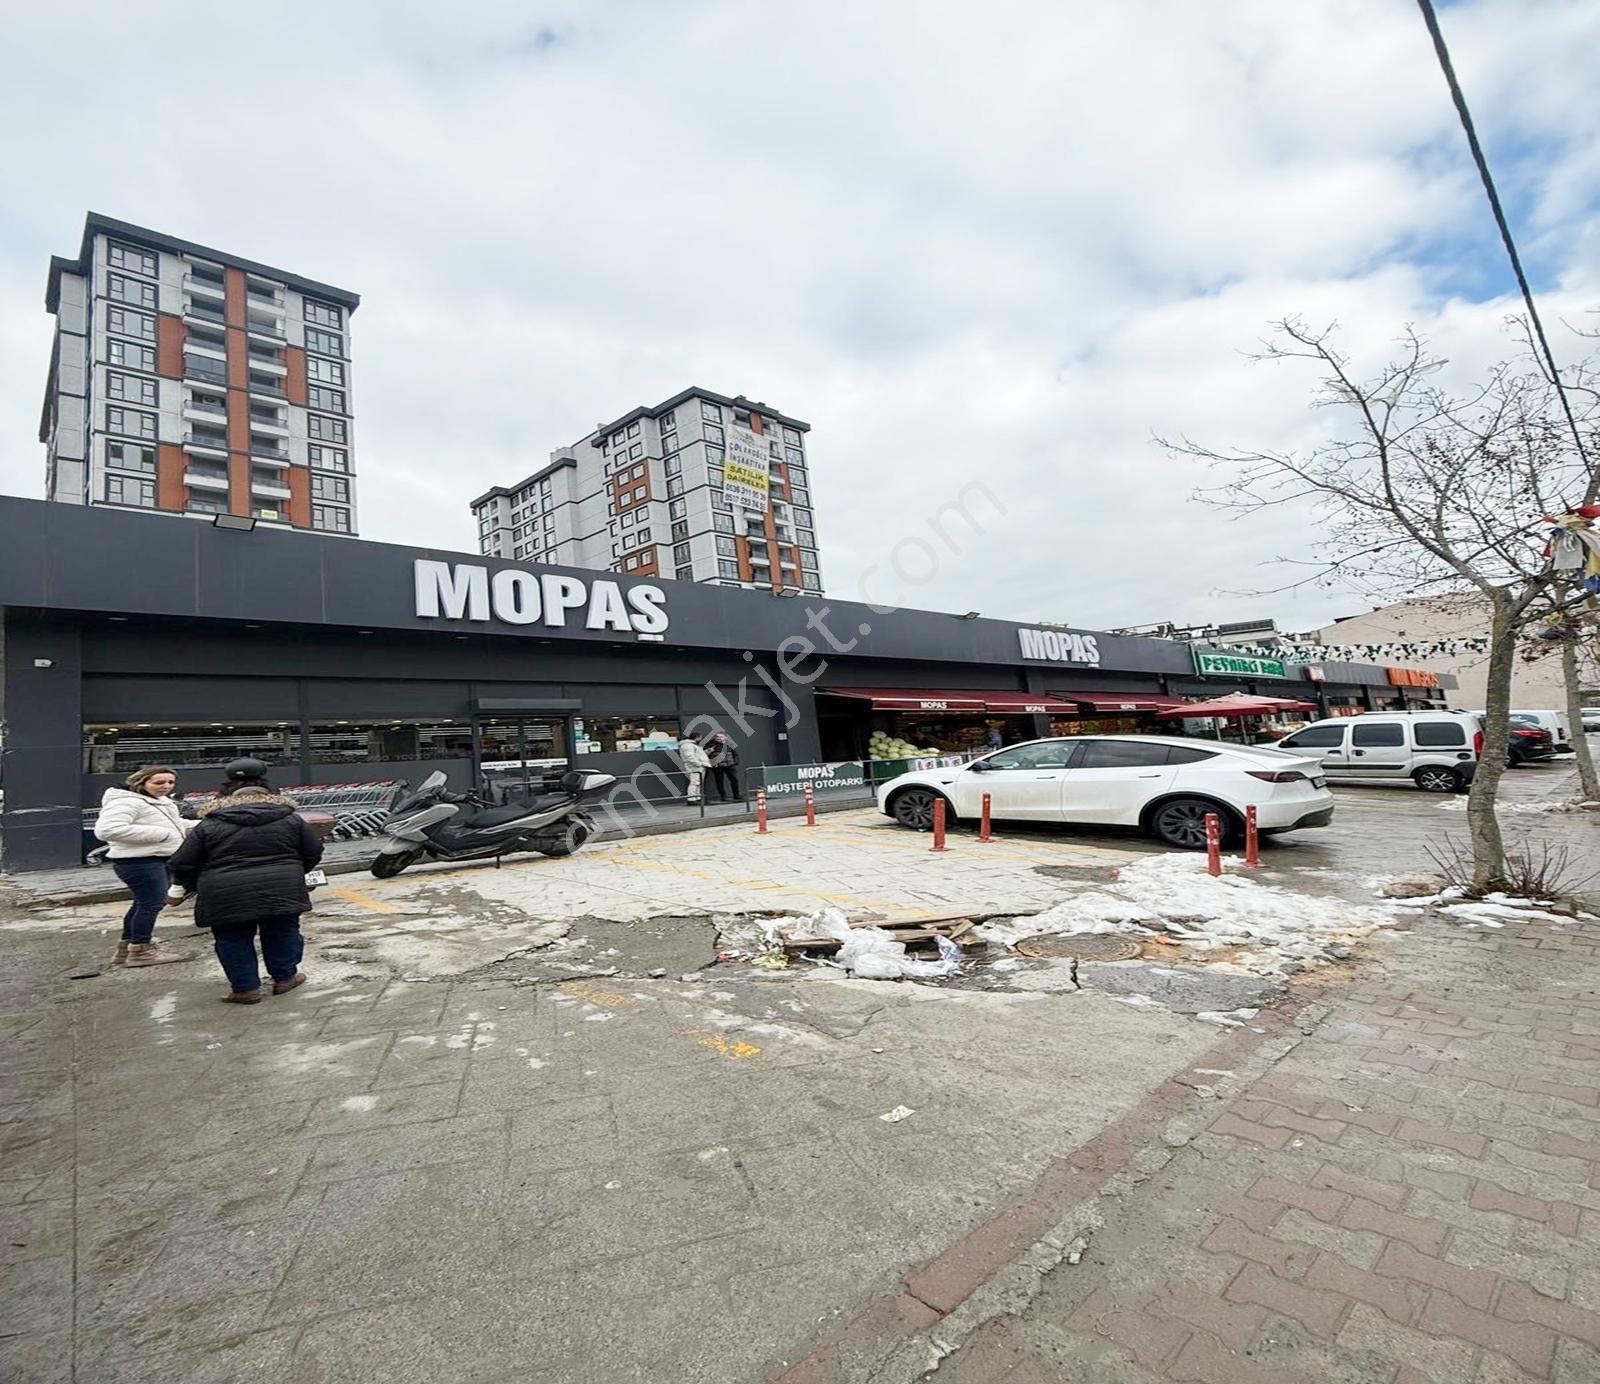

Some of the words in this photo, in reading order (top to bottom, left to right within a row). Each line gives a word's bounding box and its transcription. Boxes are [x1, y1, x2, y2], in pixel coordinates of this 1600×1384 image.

[729, 465, 764, 482] SATILIK
[413, 558, 669, 642] MOPAŞ
[1017, 628, 1100, 668] MOPAŞ
[797, 766, 835, 780] MOPAŞ
[767, 779, 813, 793] MÜŞTERİ
[814, 777, 863, 789] OTOPARKI
